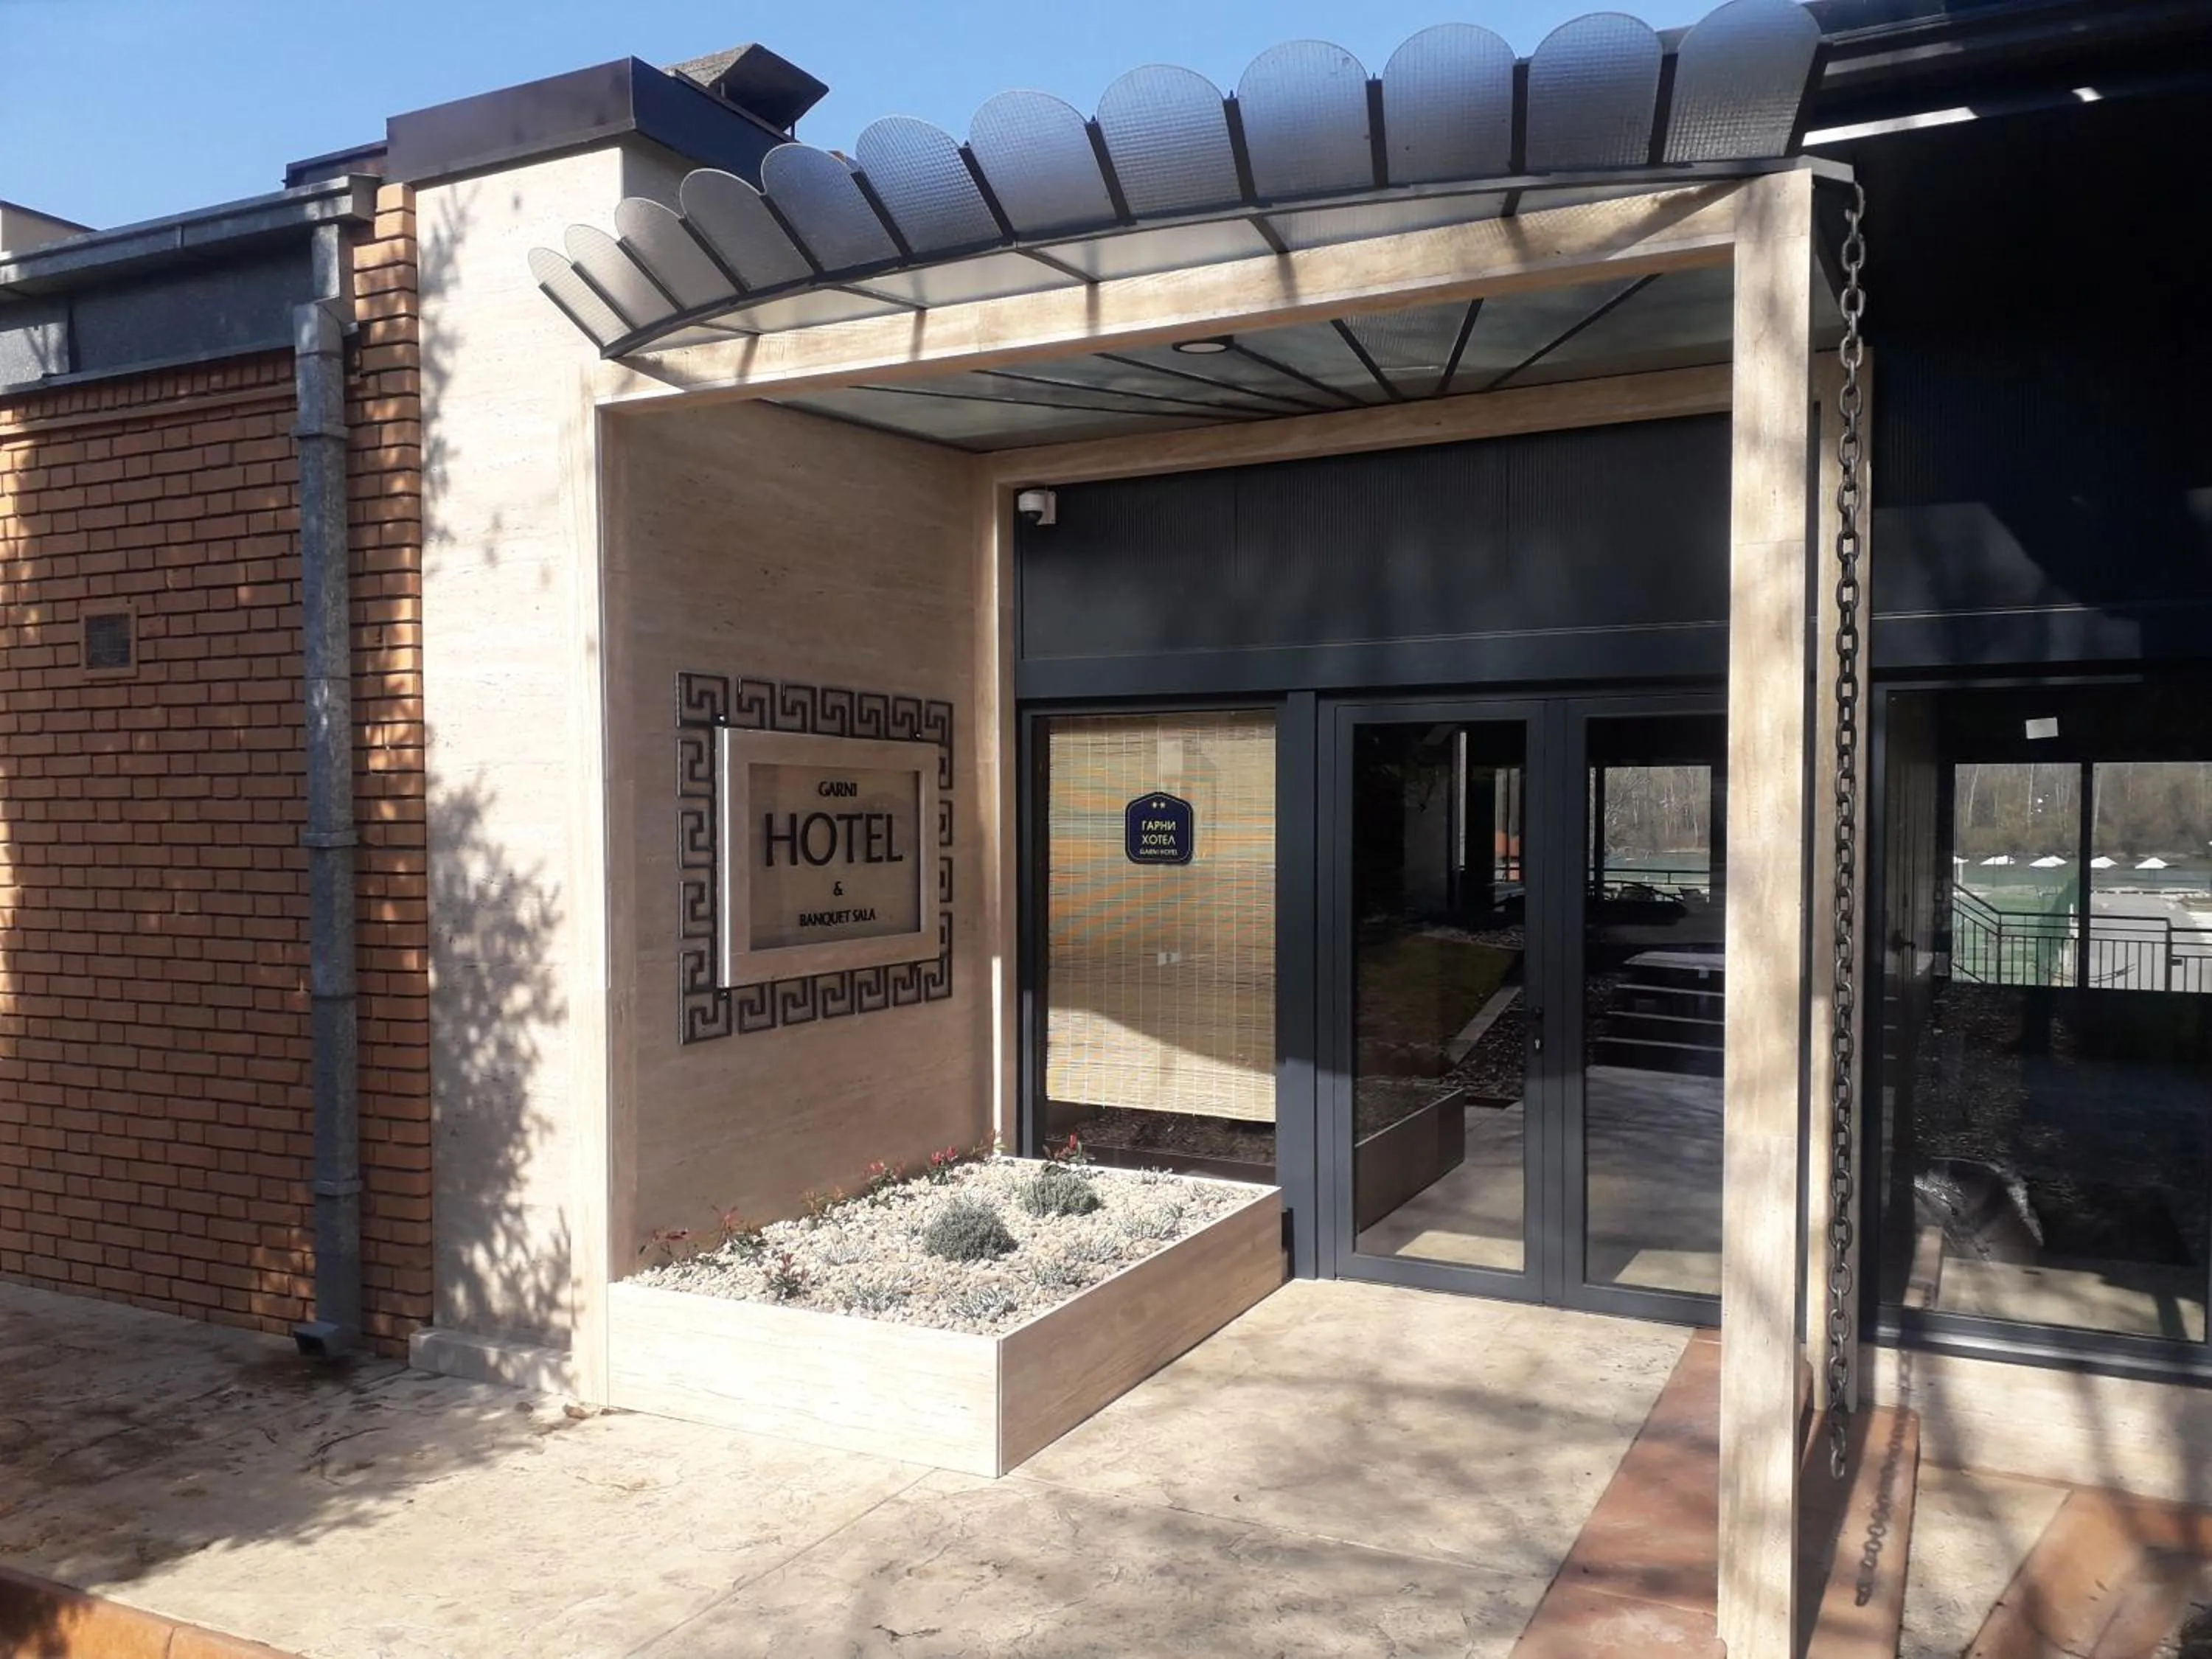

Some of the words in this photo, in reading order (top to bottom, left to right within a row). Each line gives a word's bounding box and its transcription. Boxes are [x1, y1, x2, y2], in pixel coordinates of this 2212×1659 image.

[818, 782, 858, 797] GARNI
[1141, 820, 1176, 831] ГАРНИ
[765, 812, 903, 867] HOTEL
[1142, 835, 1176, 845] ХОТЕЛ
[833, 882, 844, 896] &
[799, 910, 850, 927] BANQUET
[852, 908, 876, 922] SALA
